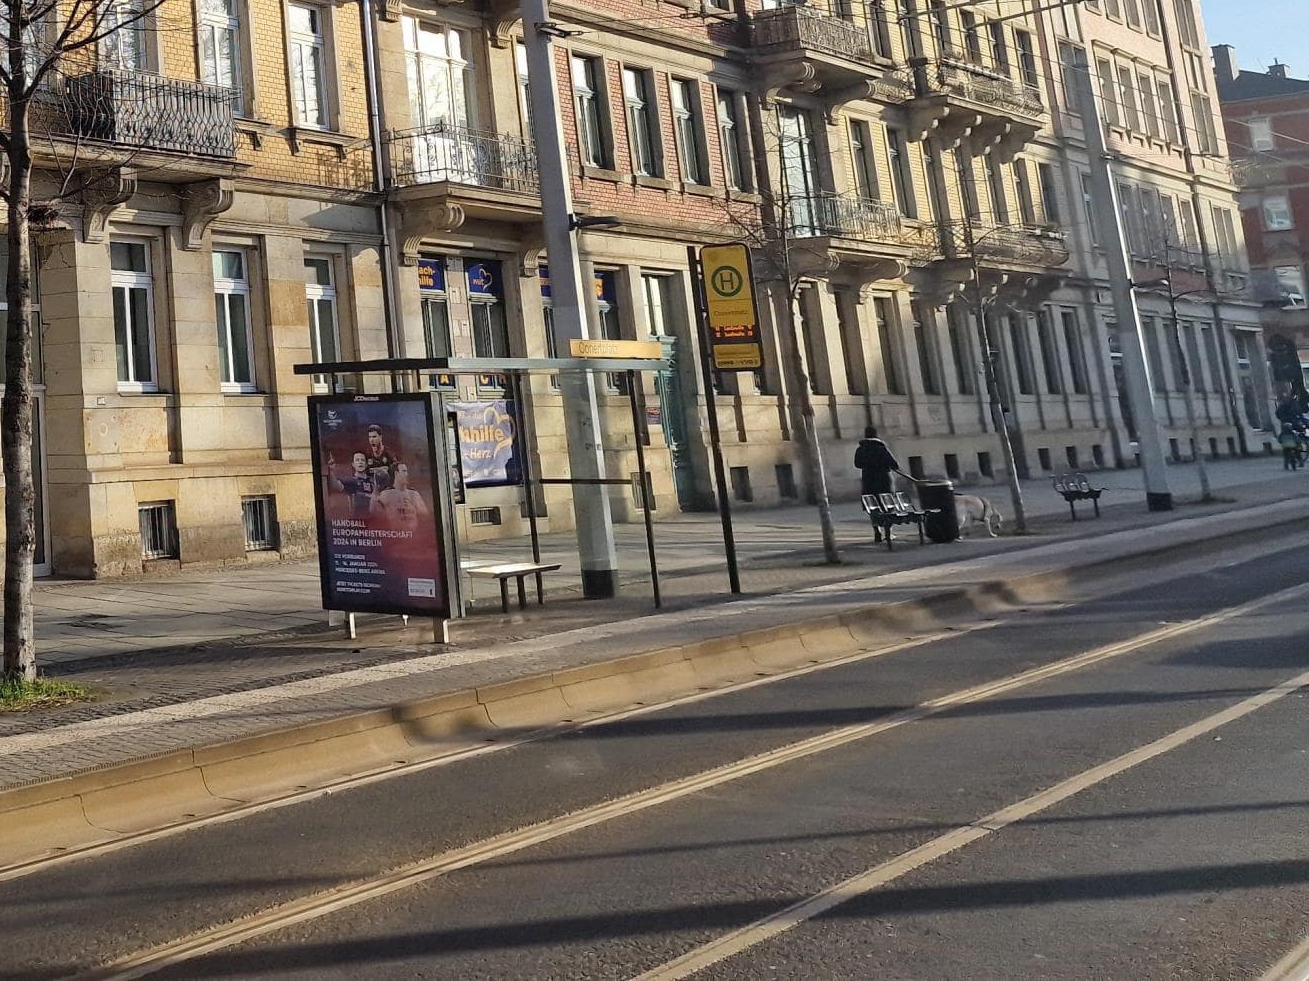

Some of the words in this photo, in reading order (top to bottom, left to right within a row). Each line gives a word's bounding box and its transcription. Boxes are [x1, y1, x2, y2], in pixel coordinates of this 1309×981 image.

[418, 265, 436, 275] ach-
[720, 272, 734, 290] H
[470, 447, 492, 459] Herz
[331, 519, 366, 528] HANDBALL
[332, 528, 413, 538] EUROPAMEISTERSCHAFT
[358, 539, 382, 547] BERLIN
